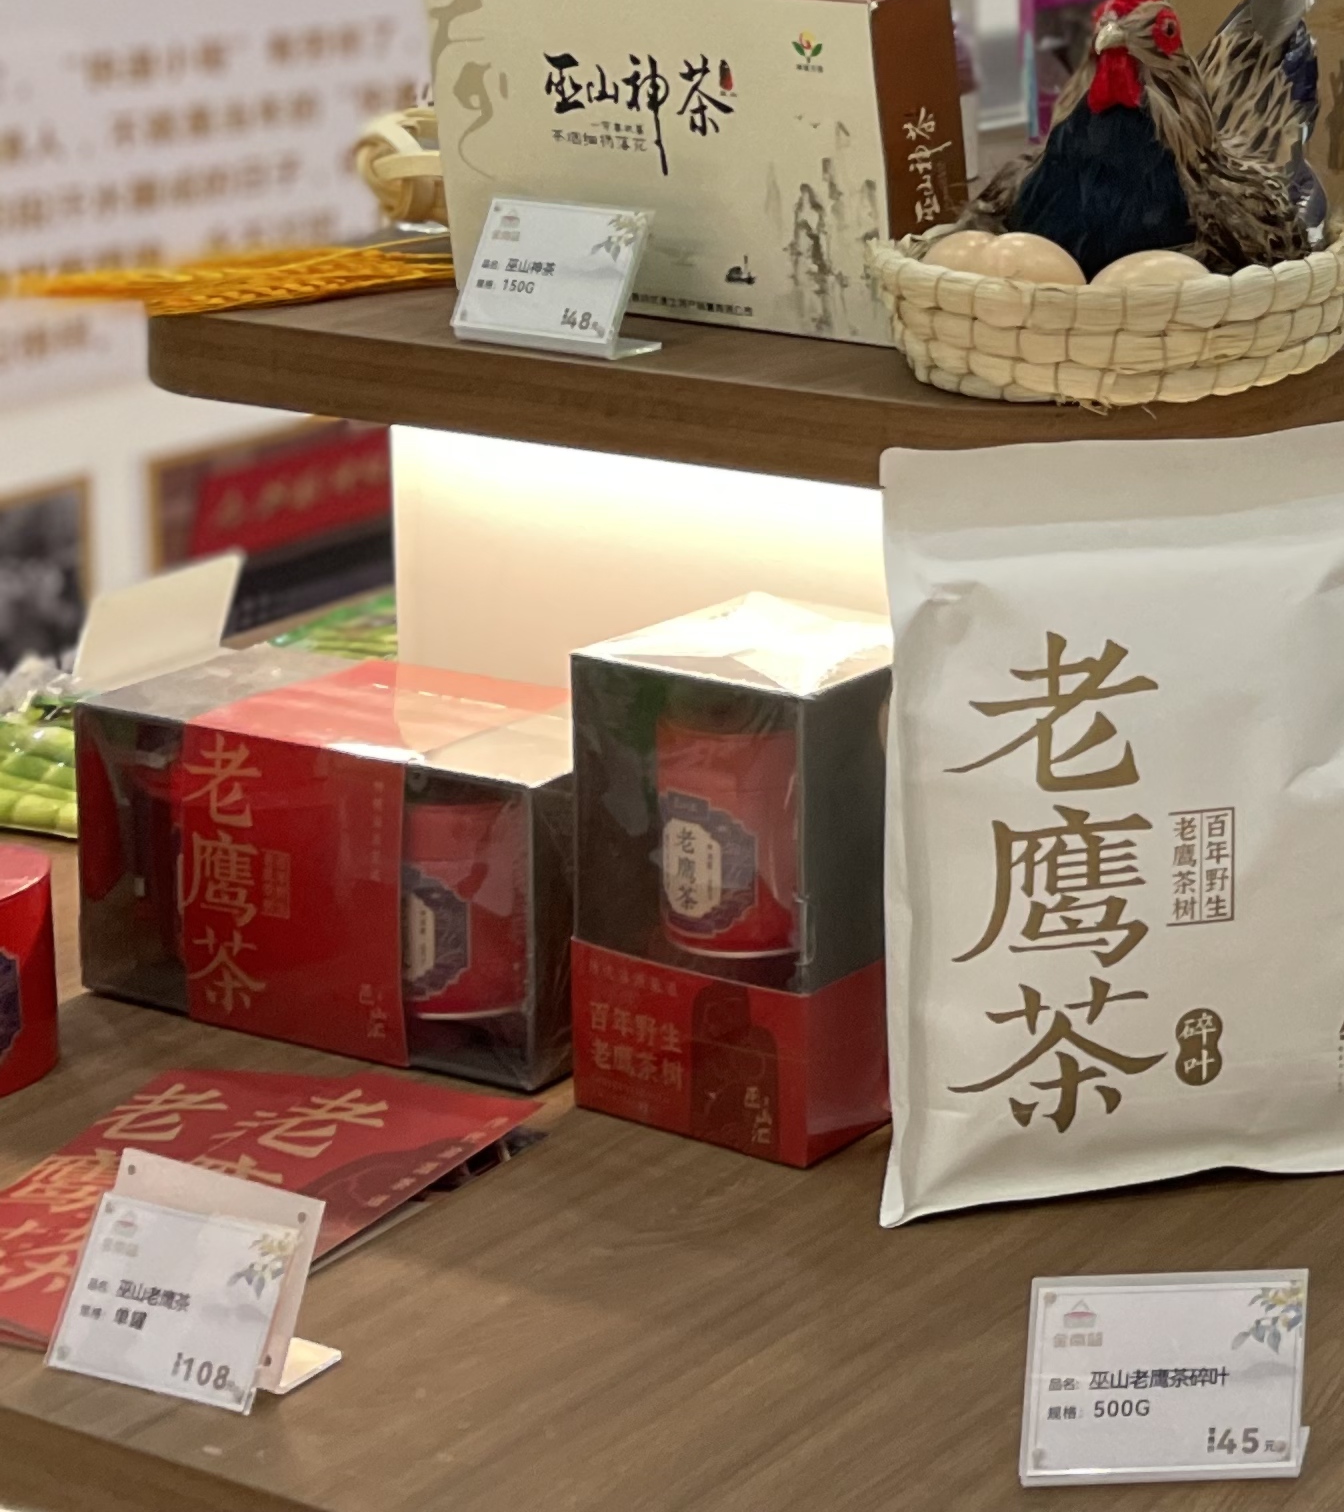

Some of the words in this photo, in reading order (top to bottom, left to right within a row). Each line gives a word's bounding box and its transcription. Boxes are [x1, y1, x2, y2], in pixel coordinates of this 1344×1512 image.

[543, 52, 735, 176] 巫山神茶
[502, 278, 535, 295] 150G
[180, 732, 266, 1015] 老鹰茶
[942, 630, 1169, 1133] 老鹰茶
[1172, 816, 1198, 921] 老鹰茶树
[1204, 812, 1230, 919] 百年野生
[1178, 1011, 1217, 1081] 碎叶
[182, 1355, 231, 1390] 108
[1088, 1366, 1230, 1390] 巫山老鹰茶碎叶
[1093, 1399, 1150, 1419] 500G
